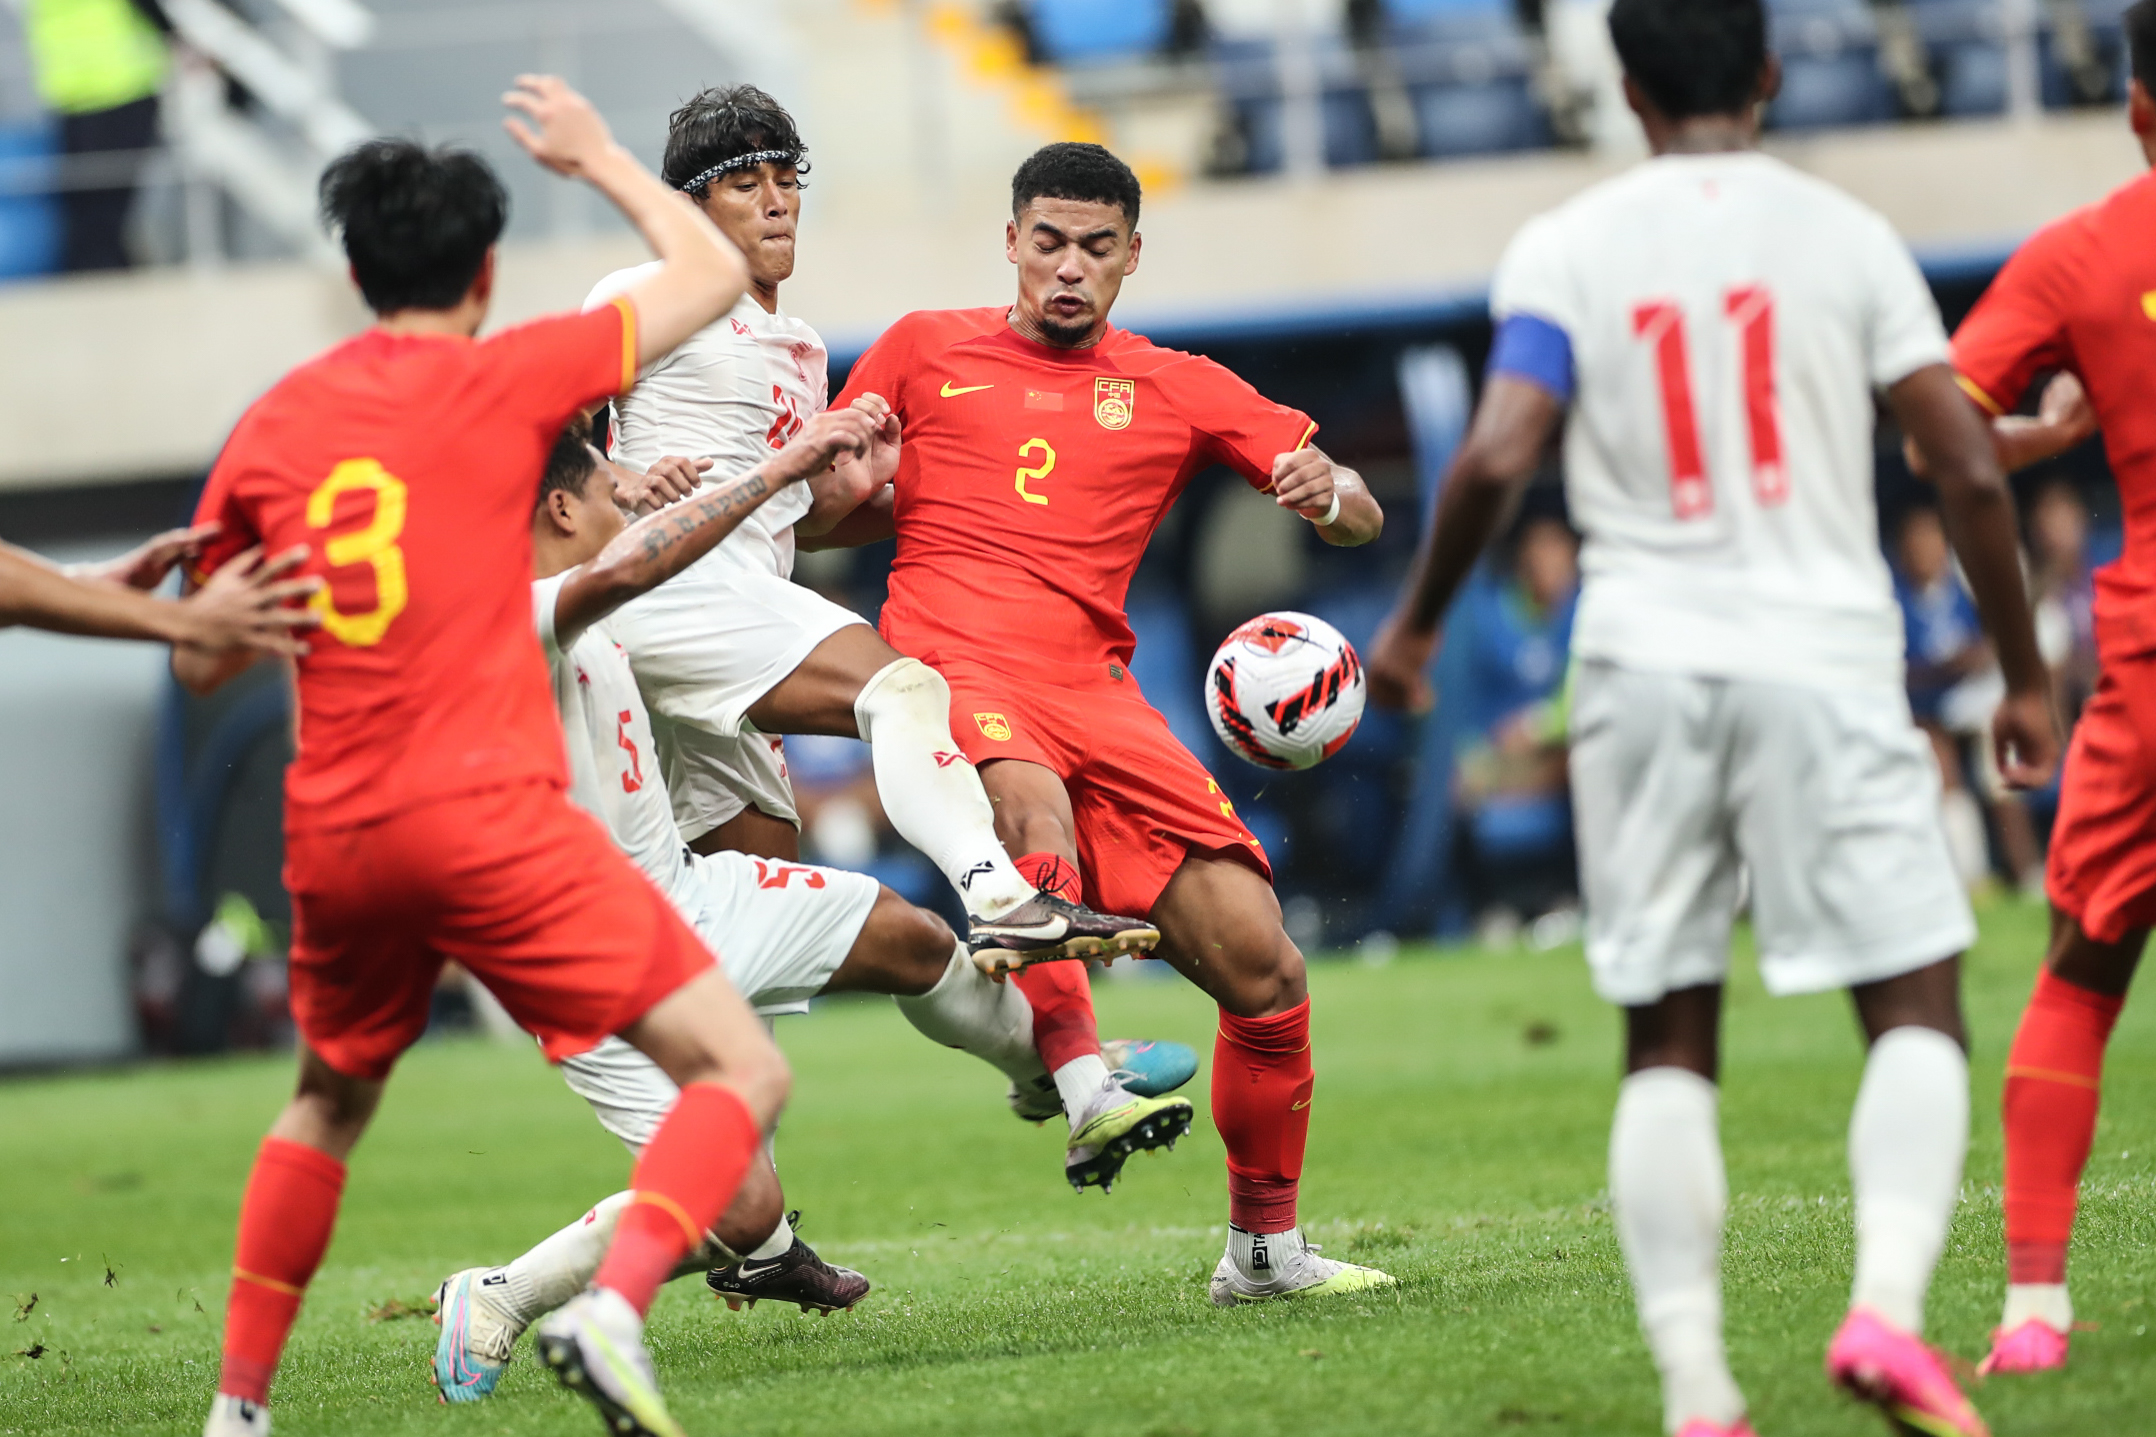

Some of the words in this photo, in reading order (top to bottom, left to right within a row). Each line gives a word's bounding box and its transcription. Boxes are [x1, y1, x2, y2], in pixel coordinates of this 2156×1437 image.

[1099, 381, 1131, 393] CFA
[1630, 281, 1790, 521] 11
[1015, 437, 1057, 505] 2
[306, 457, 408, 647] 3
[618, 709, 643, 793] 5
[754, 860, 826, 889] 5
